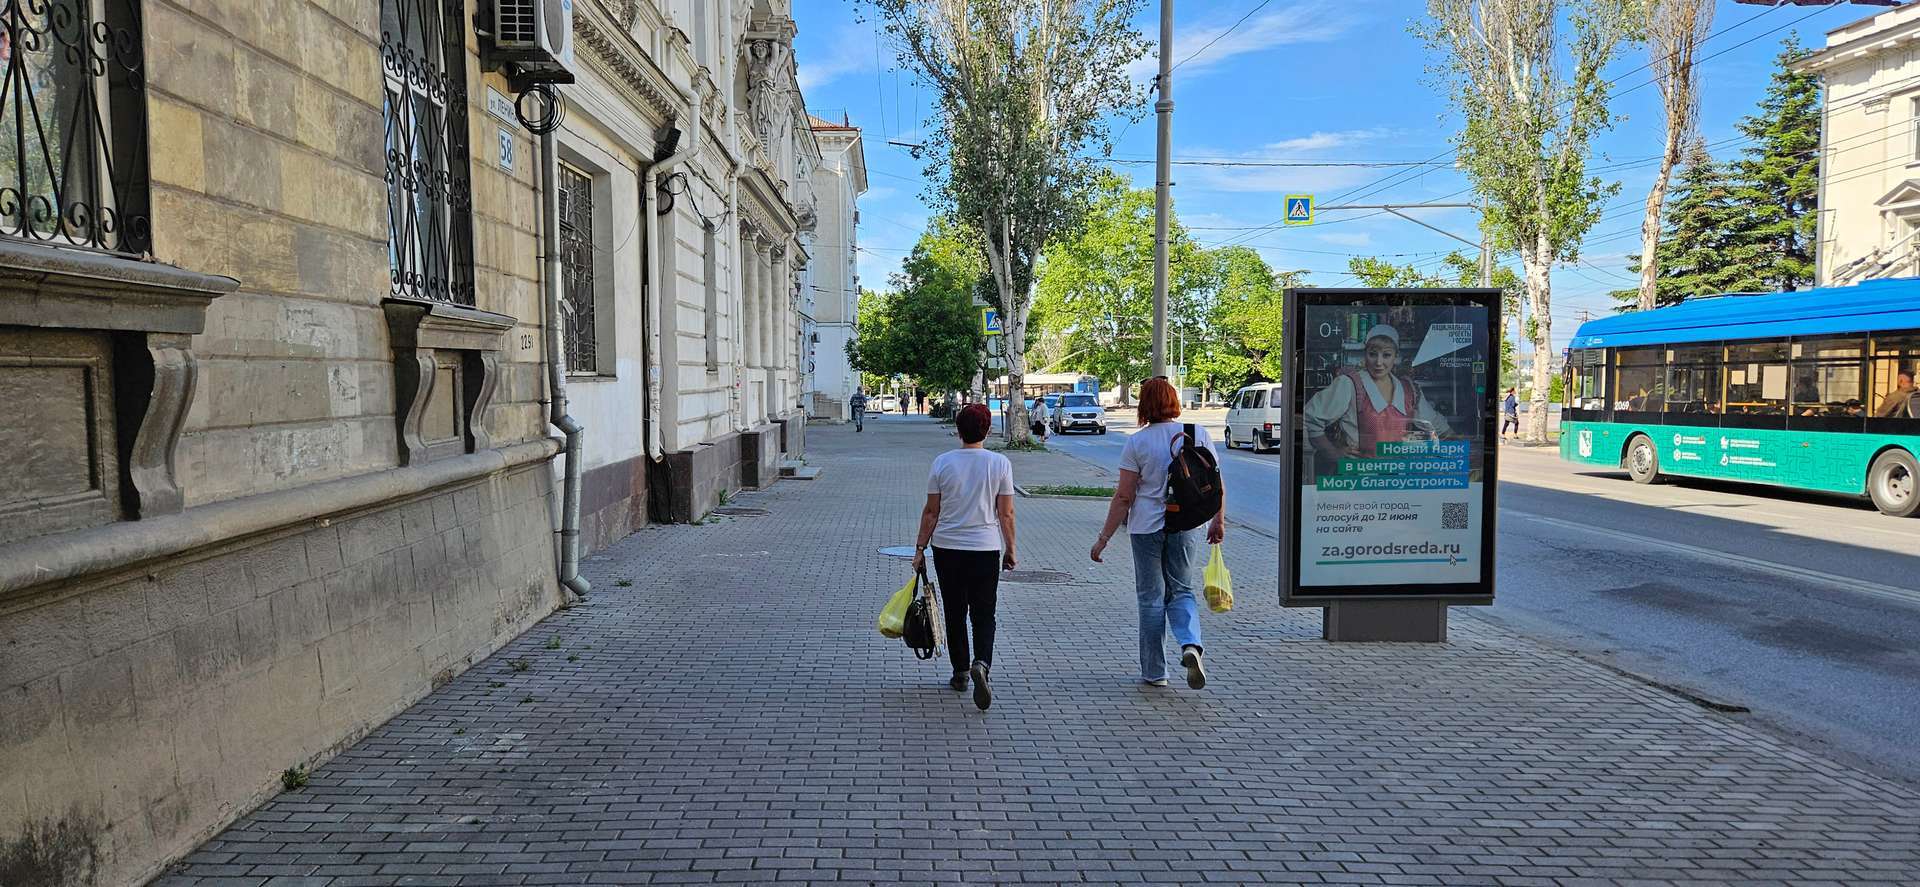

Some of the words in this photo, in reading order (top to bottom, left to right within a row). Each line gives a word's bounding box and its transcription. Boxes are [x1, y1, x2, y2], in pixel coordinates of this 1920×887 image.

[501, 135, 512, 164] 58
[1319, 322, 1342, 338] 0+
[1614, 400, 1630, 411] 2069
[1383, 442, 1428, 455] Новый
[1345, 463, 1353, 471] в
[1357, 461, 1406, 474] центре
[1409, 459, 1464, 473] города?
[1323, 477, 1357, 490] Могу
[1361, 476, 1463, 489] благоустроить.
[1316, 502, 1351, 511] Меняй
[1353, 502, 1378, 511] свой
[1380, 502, 1410, 512] город
[1315, 512, 1359, 523] голосуй
[1361, 512, 1375, 522] до
[1377, 512, 1387, 521] 12
[1389, 513, 1418, 521] июня
[1315, 526, 1330, 534] на
[1332, 524, 1364, 534] сайте
[1321, 540, 1461, 559] za.gorodsreda.ru
